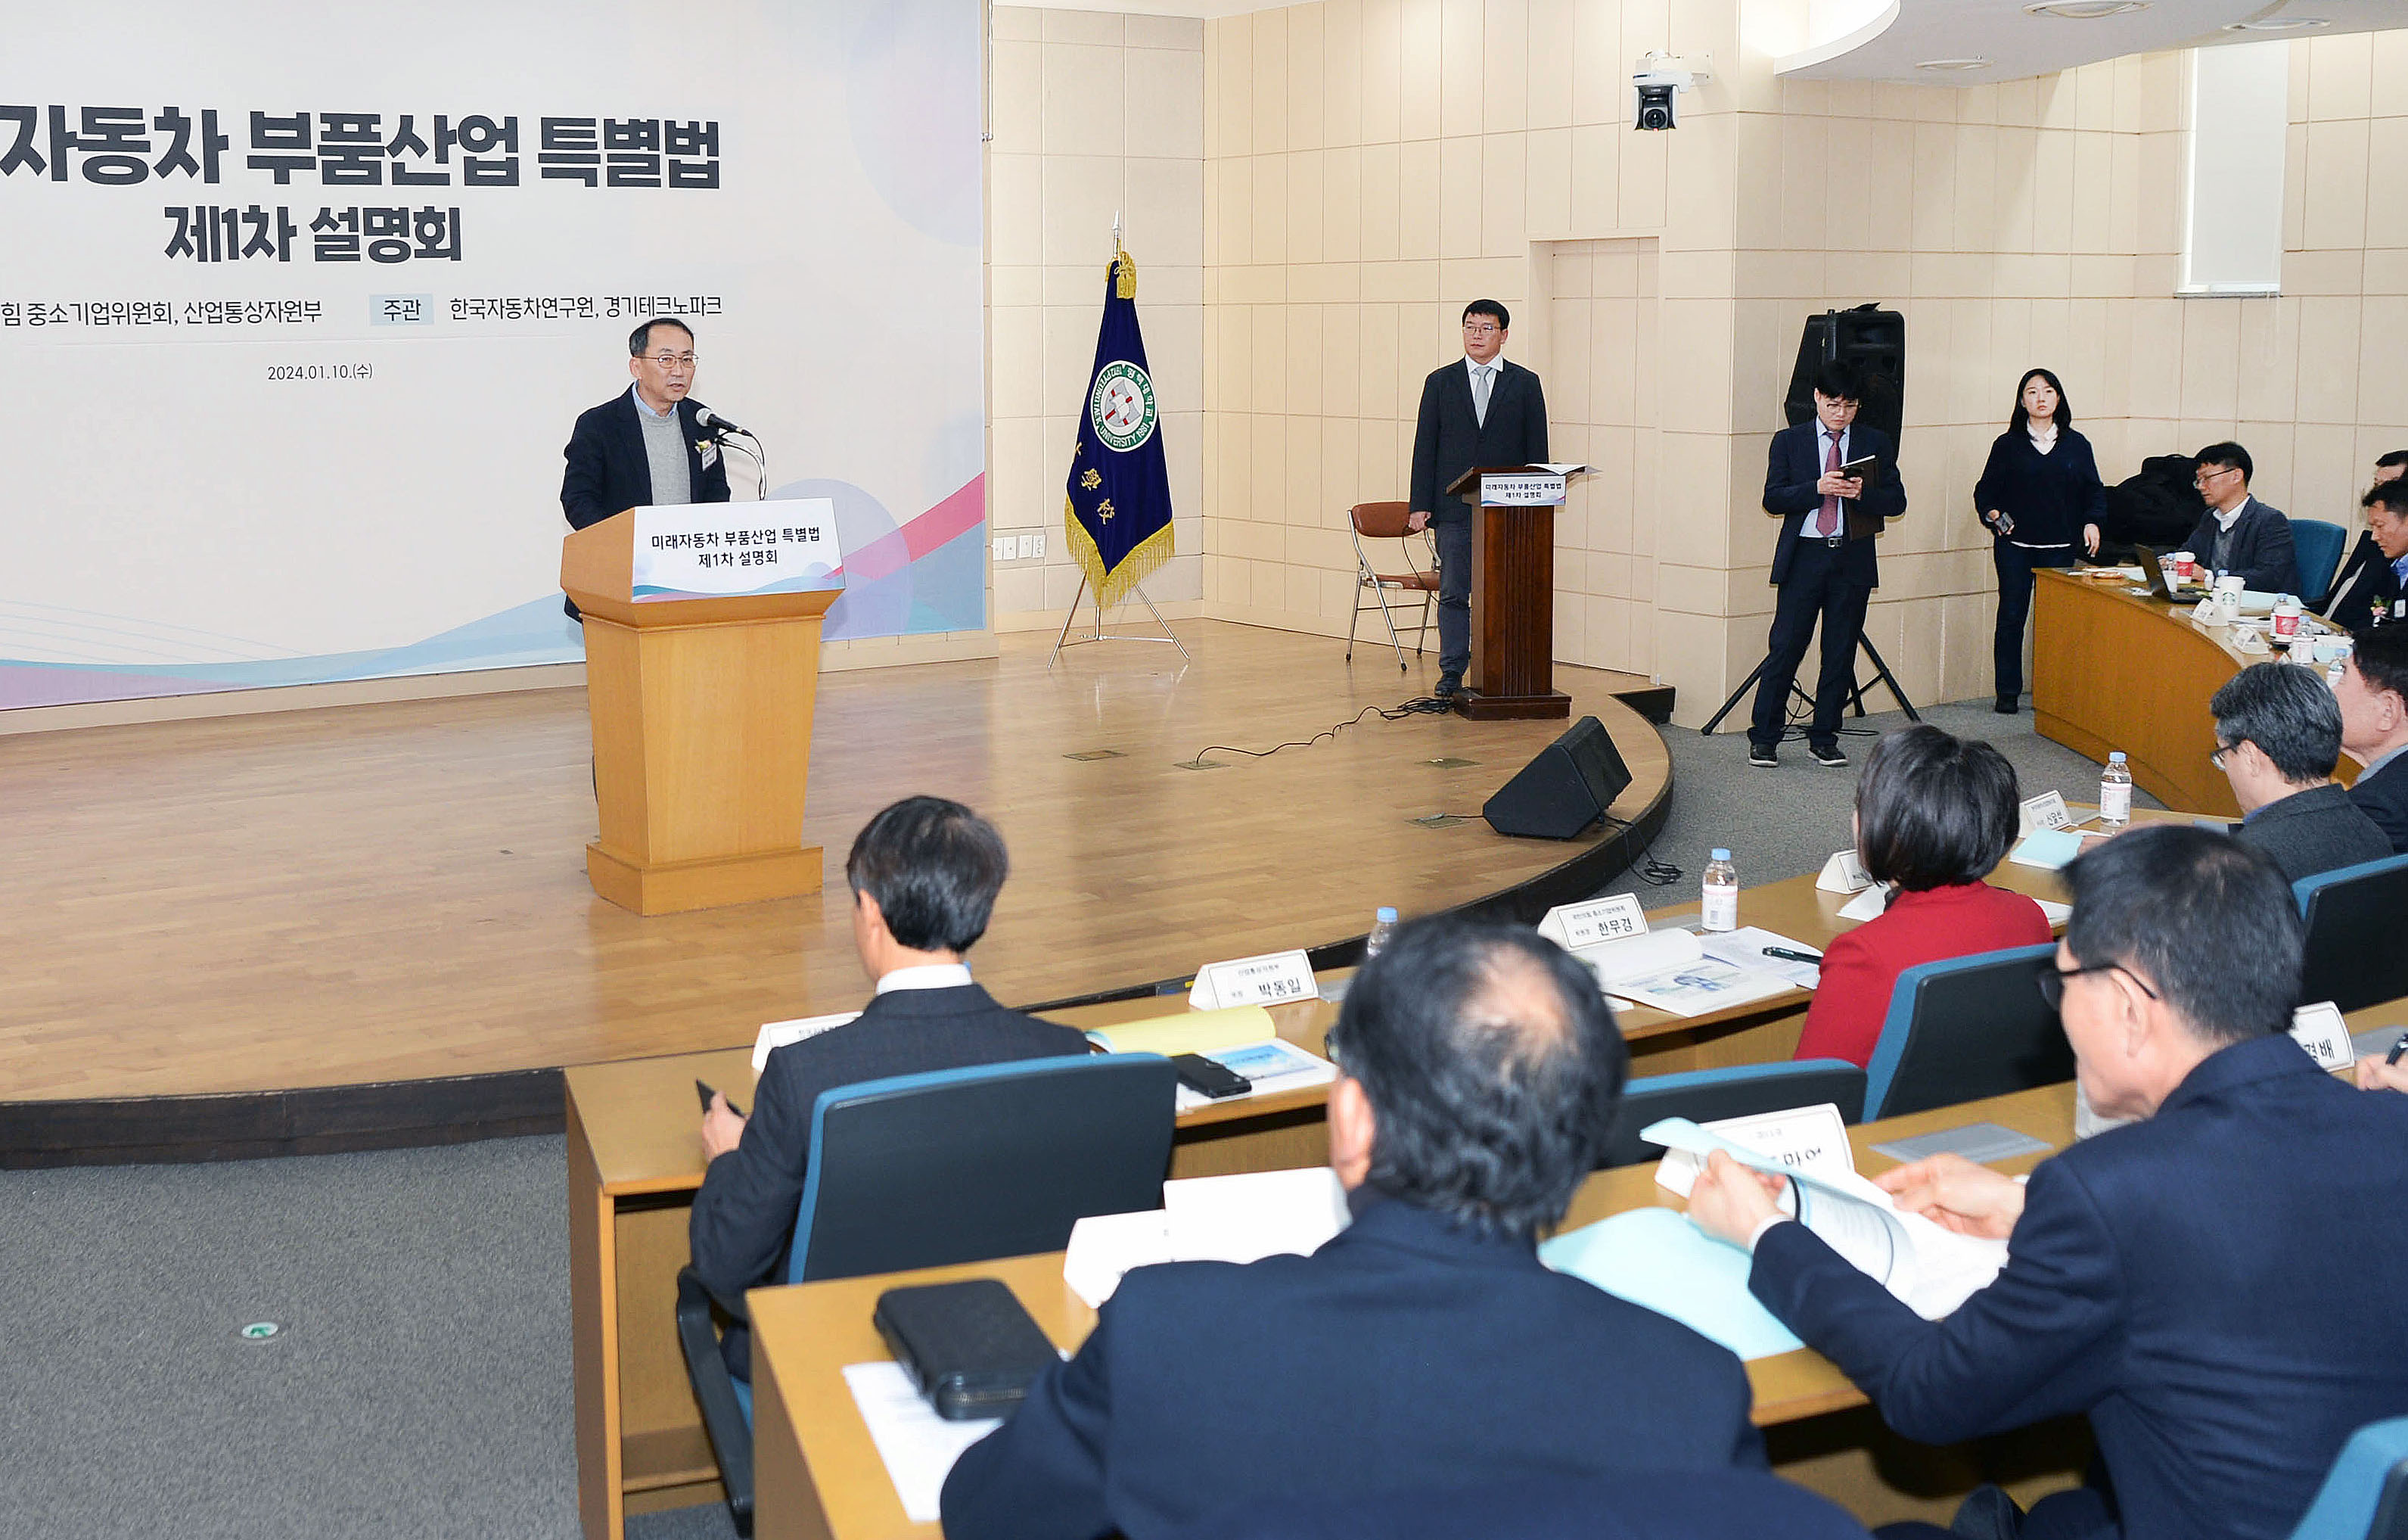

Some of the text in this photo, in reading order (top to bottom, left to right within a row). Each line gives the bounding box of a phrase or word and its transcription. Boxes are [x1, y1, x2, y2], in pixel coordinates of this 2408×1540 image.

[0, 104, 721, 190] 자동차 부품산업 특별법
[164, 205, 462, 263] 제1차 설명회
[27, 302, 179, 326] 중소기업위원회,
[184, 300, 322, 325] 산업통상자원부
[384, 299, 421, 322] 주관
[450, 295, 722, 320] 한국자동차연구원, 경기테크노파크
[268, 363, 373, 380] 2024.01.10.(수)
[651, 526, 820, 550] 미래자동차 부품산업 특별법
[698, 549, 778, 568] 제1차 설명회
[1599, 917, 1633, 936] 한무경
[1258, 977, 1301, 997] 박동일
